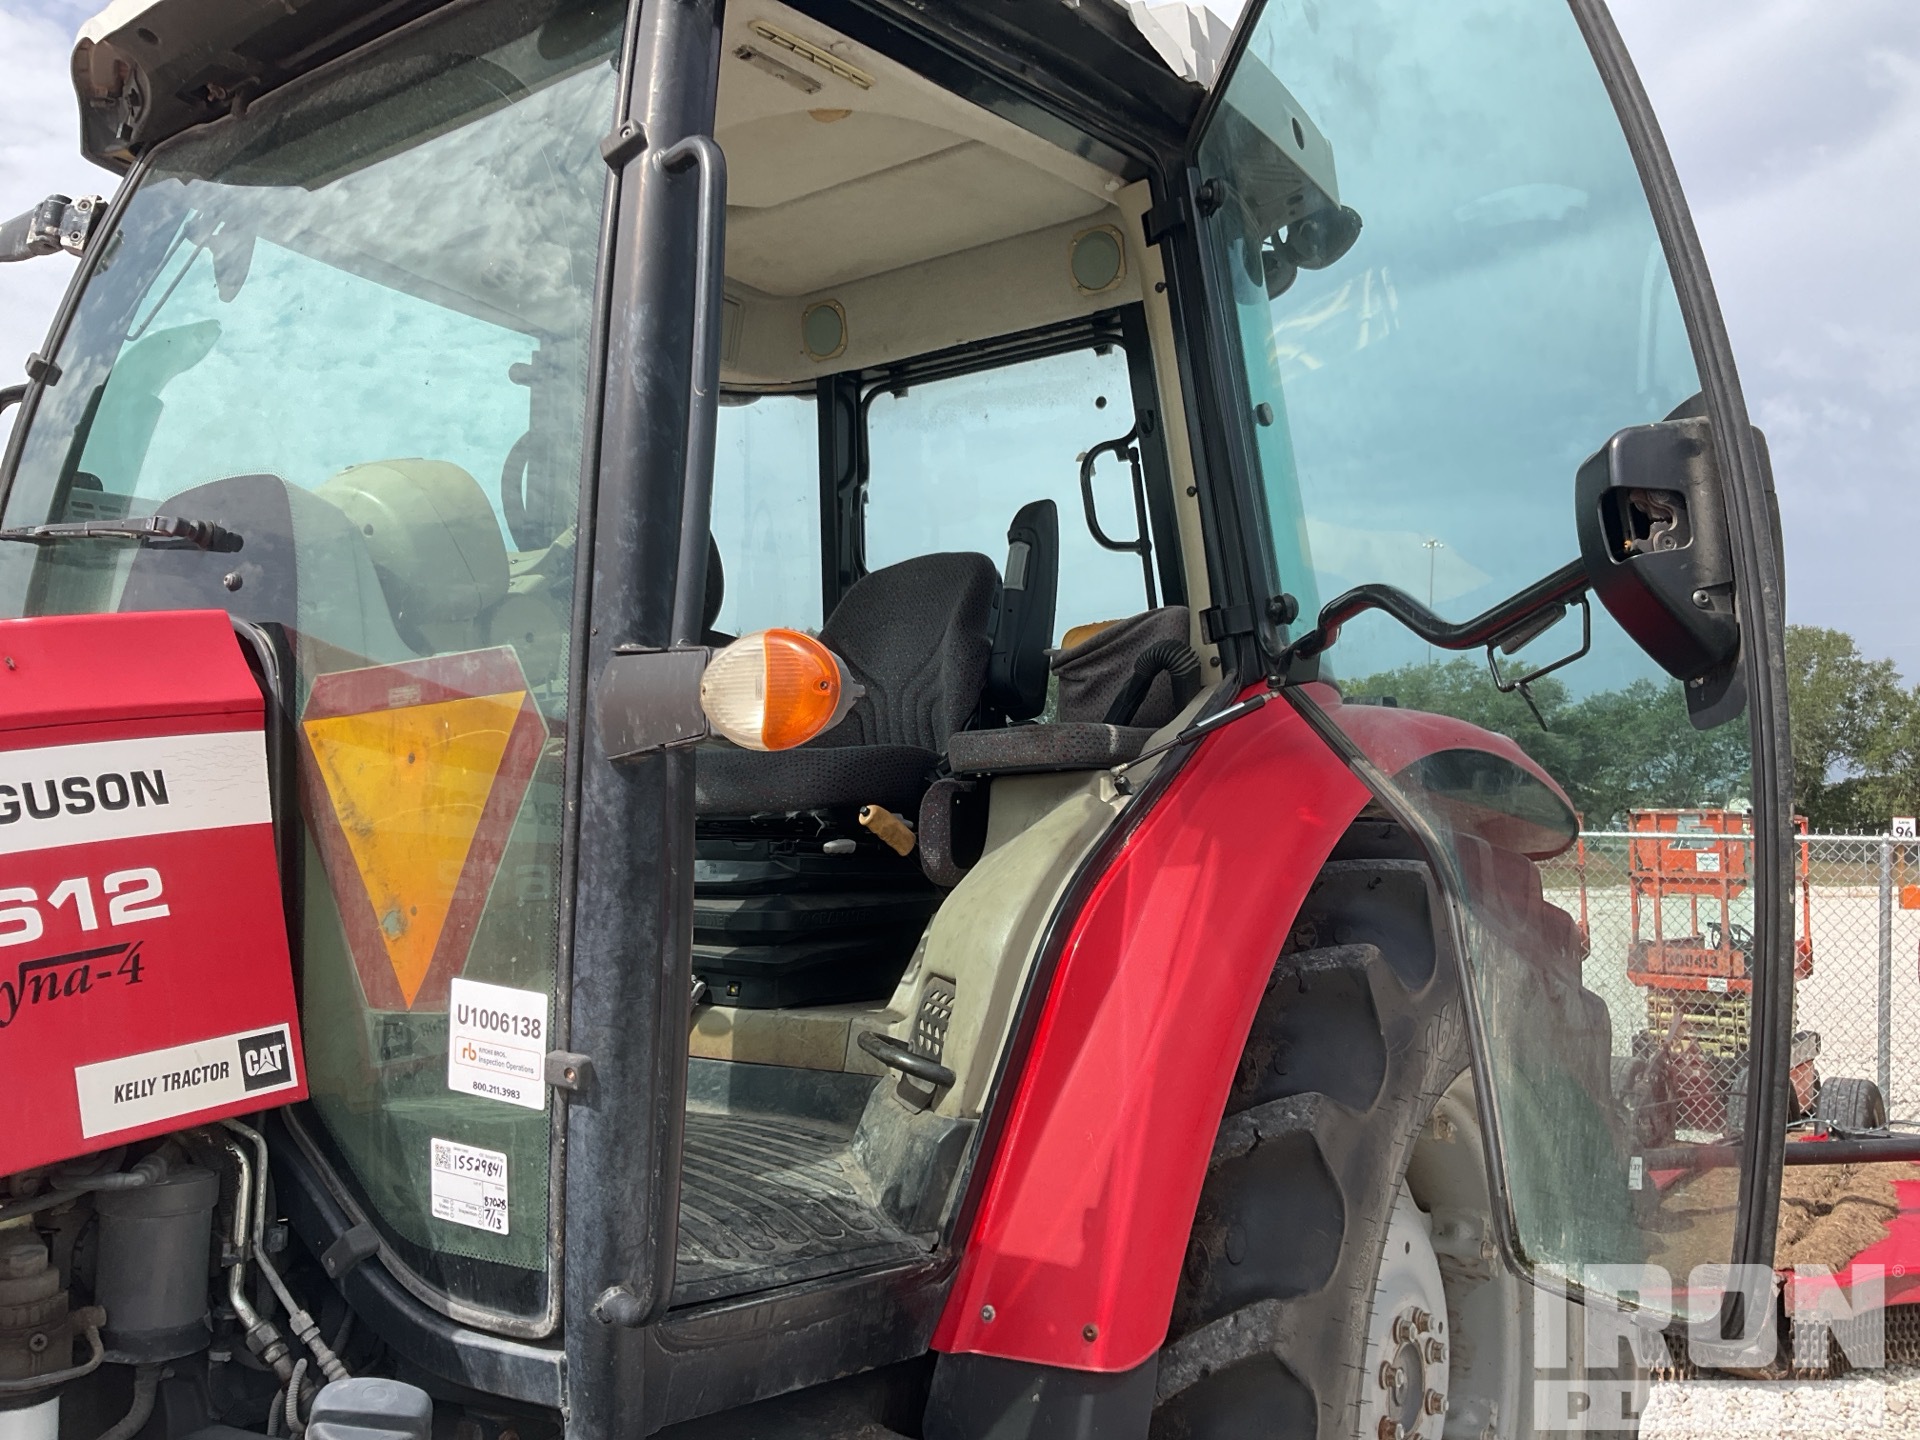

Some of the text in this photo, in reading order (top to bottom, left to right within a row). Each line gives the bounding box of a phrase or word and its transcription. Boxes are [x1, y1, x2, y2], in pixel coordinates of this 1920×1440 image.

[0, 769, 169, 825] GUSON
[1895, 826, 1913, 838] 96
[457, 1003, 541, 1039] U1006138
[245, 1044, 284, 1076] CAT
[478, 1056, 535, 1074] Inspection Operations
[114, 1061, 230, 1104] KELLY TRACTOR
[472, 1081, 521, 1100] 800.211.3983
[454, 1154, 503, 1178] 15529841
[484, 1209, 502, 1230] 7/13
